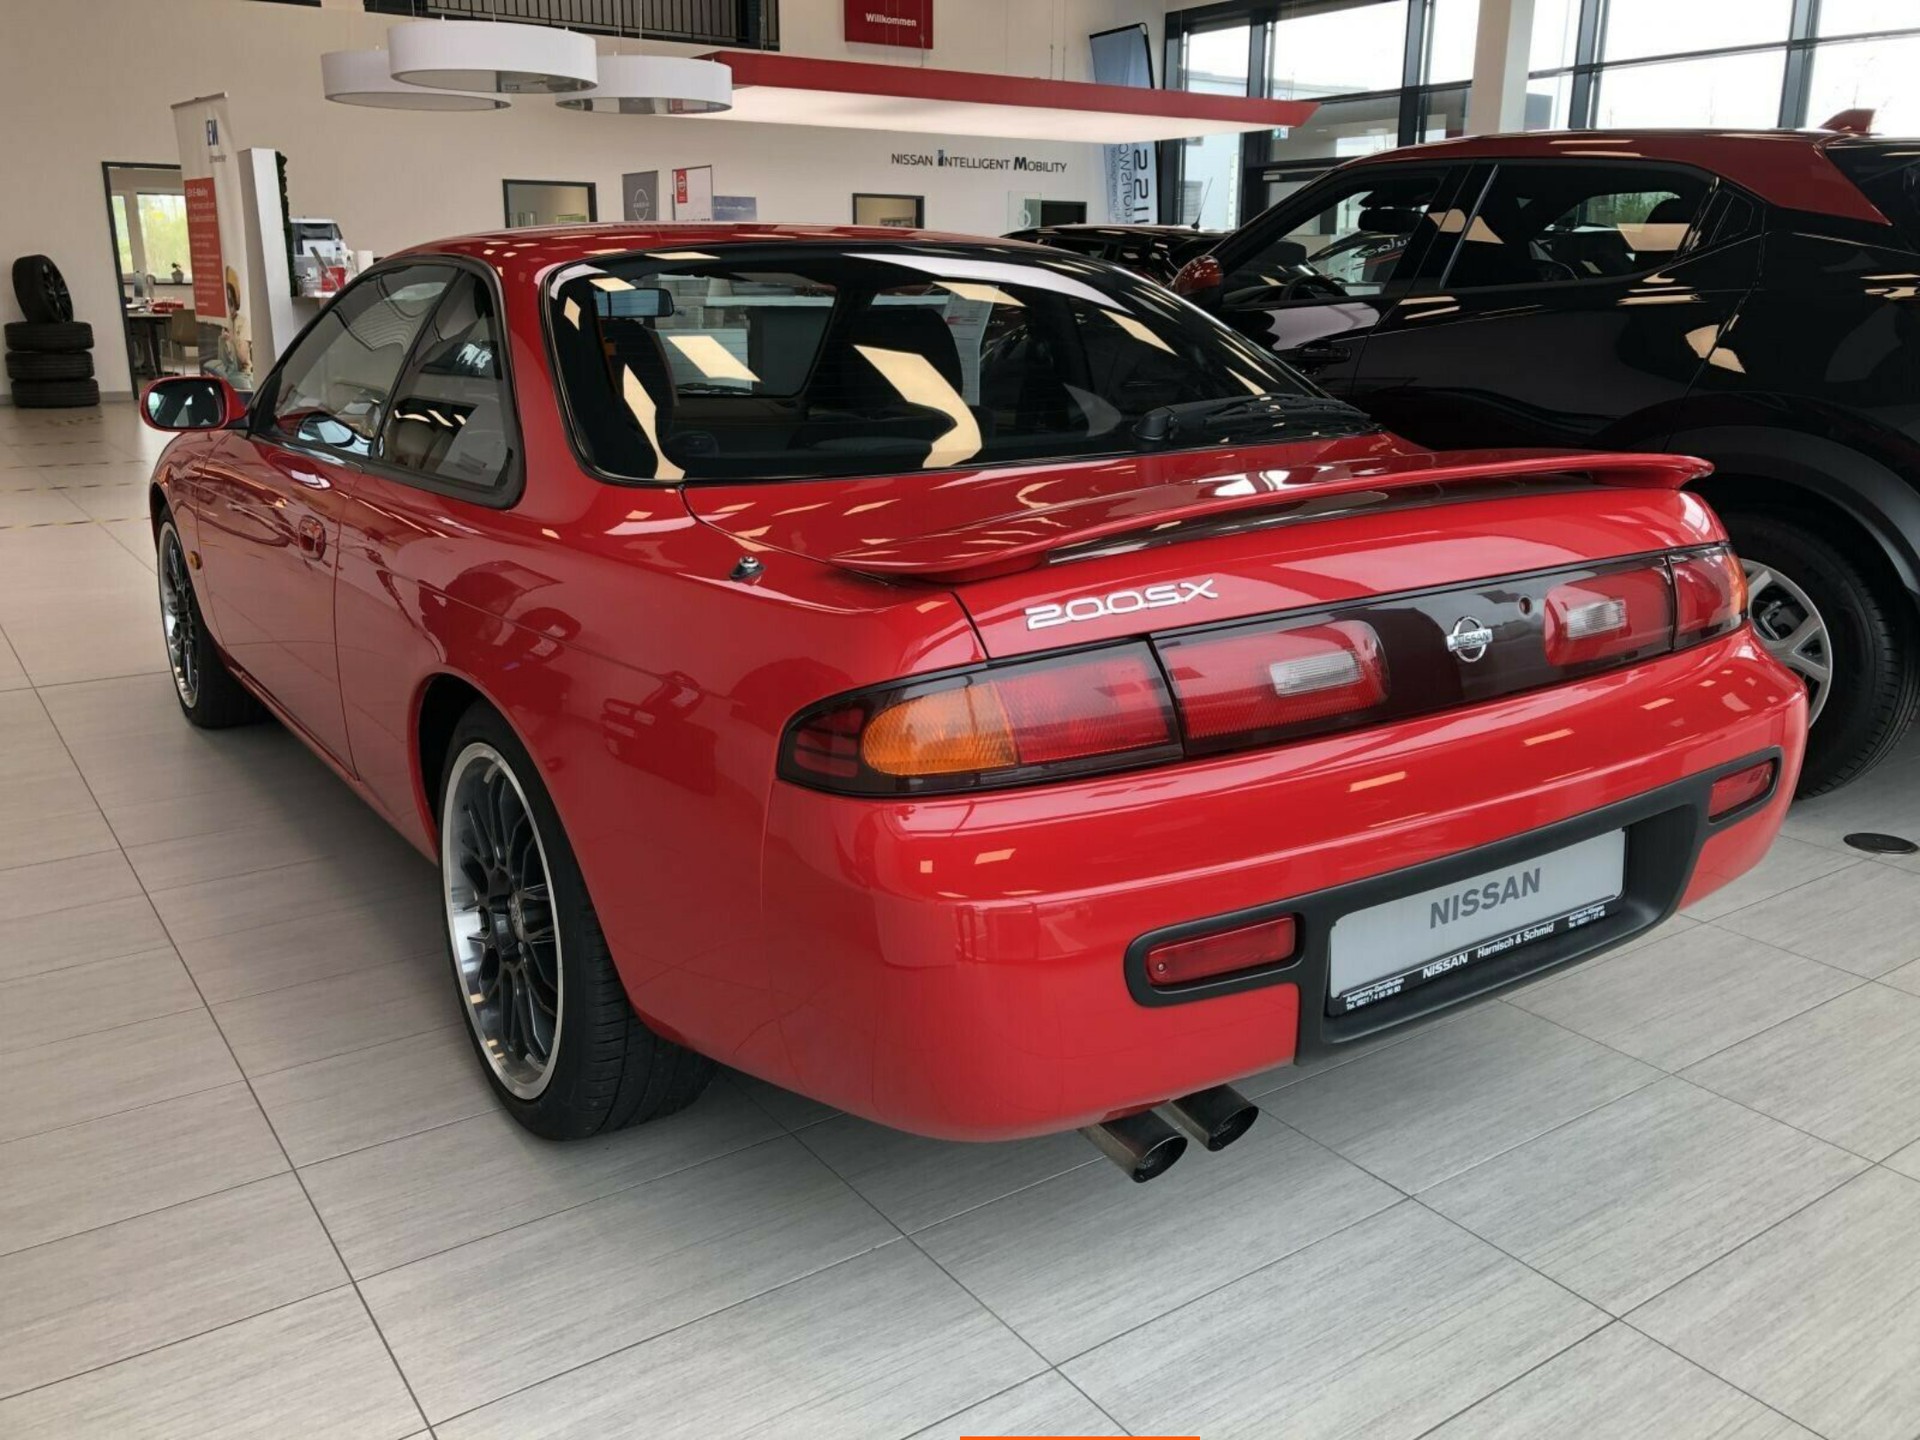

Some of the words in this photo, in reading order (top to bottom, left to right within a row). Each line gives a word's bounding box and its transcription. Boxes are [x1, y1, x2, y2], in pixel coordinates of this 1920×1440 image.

[865, 12, 917, 27] Willkommen
[891, 153, 933, 166] NISSAN
[937, 149, 1011, 170] INTELLIGENT
[1014, 156, 1068, 173] MOBILITY
[1024, 578, 1219, 631] 200SX
[1453, 631, 1490, 647] NISSAN
[1430, 867, 1541, 930] NISSAN
[1422, 952, 1469, 980] NISSAN
[1477, 937, 1514, 959] Harnisch
[1515, 933, 1523, 944] &
[1523, 923, 1555, 942] Schmid
